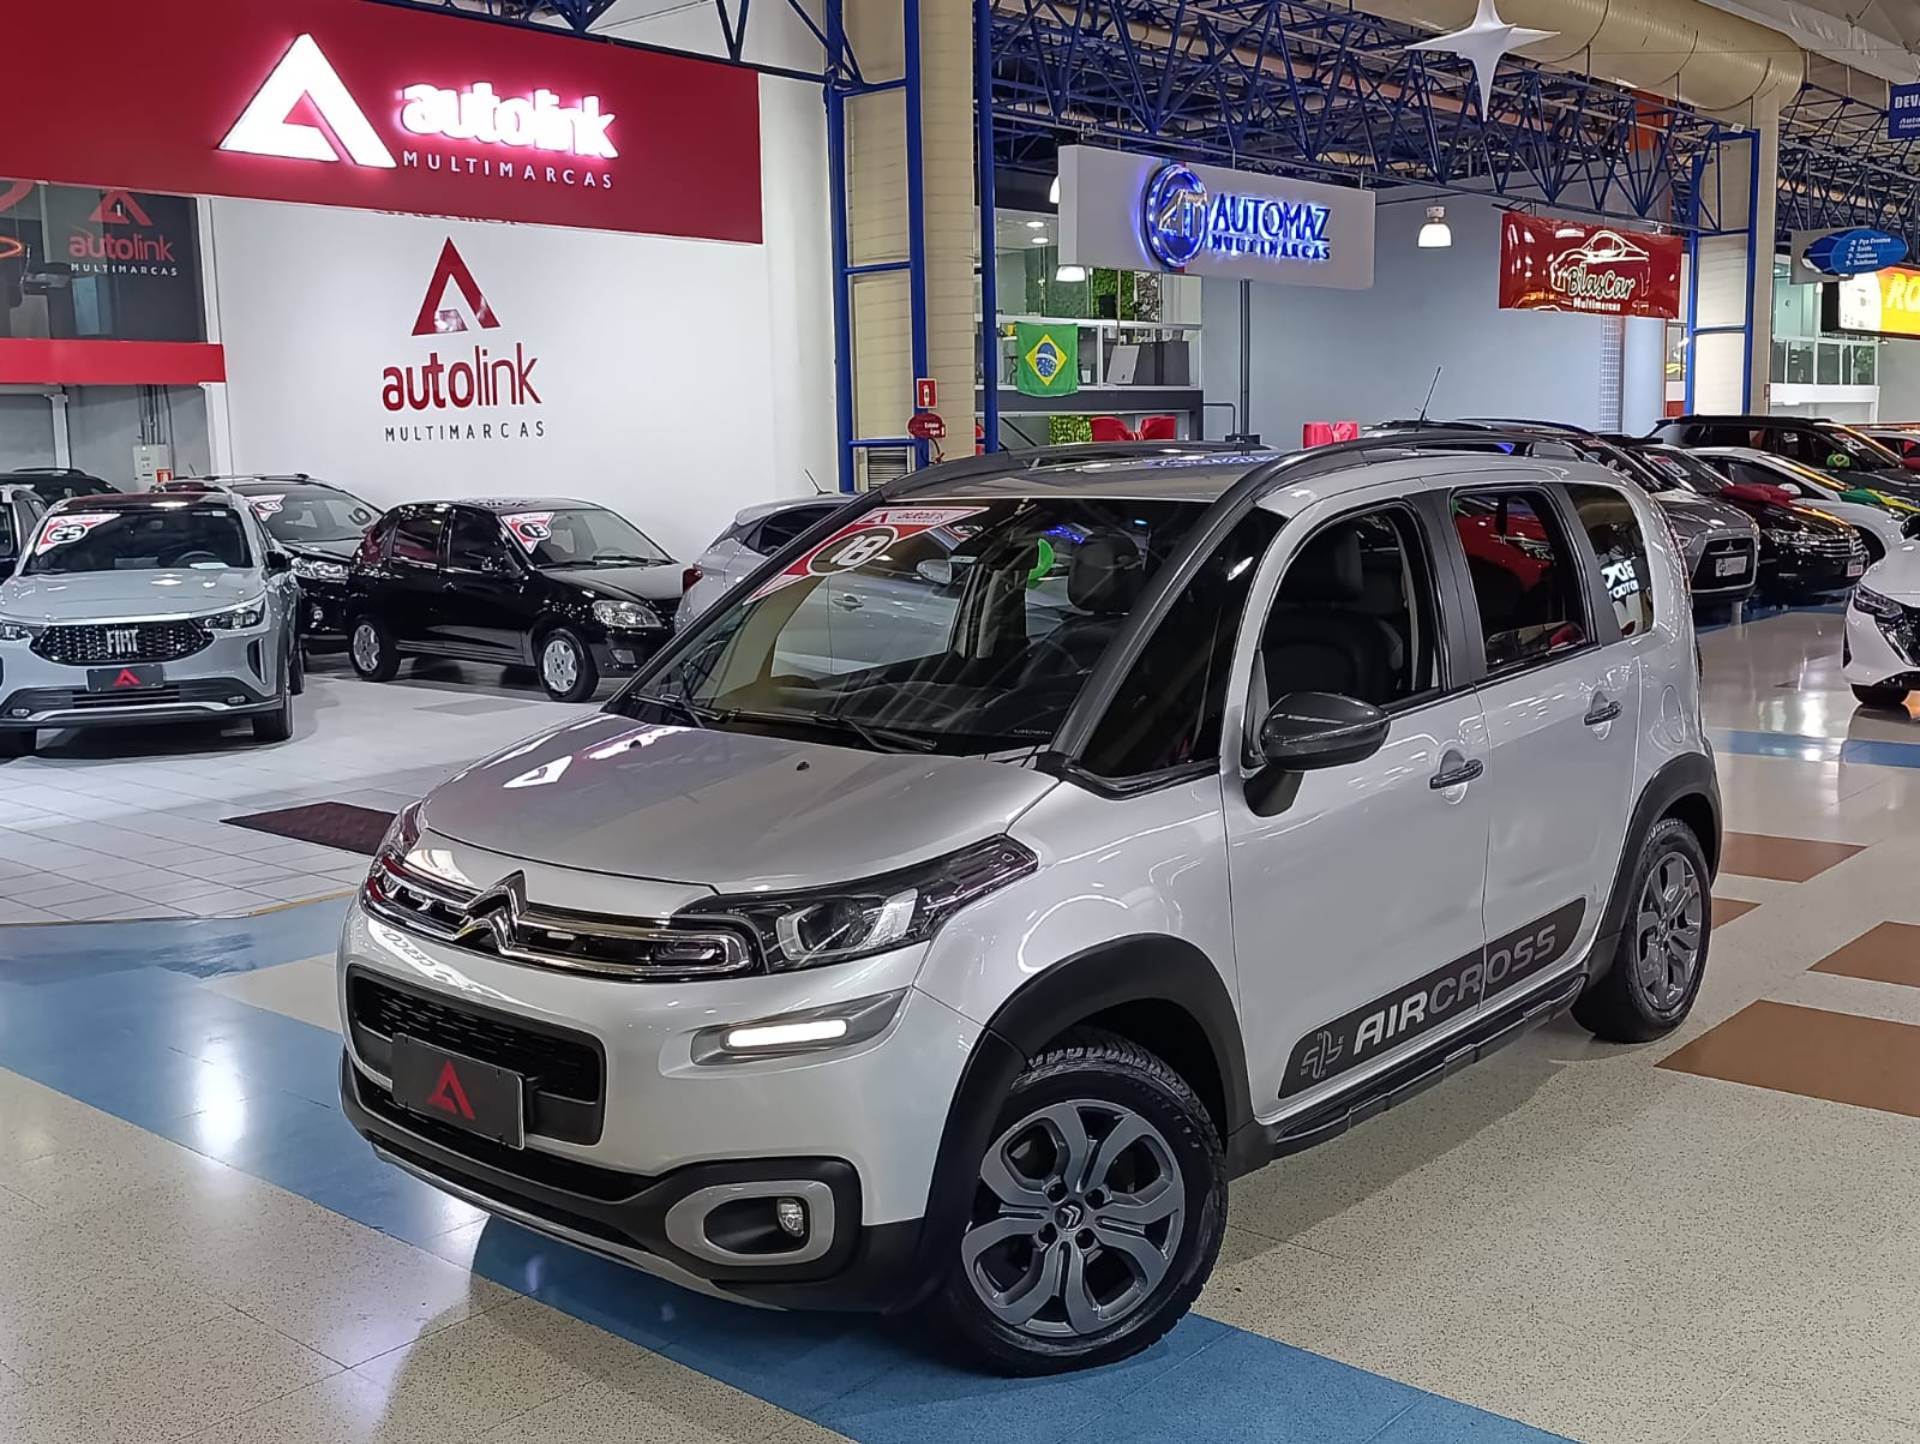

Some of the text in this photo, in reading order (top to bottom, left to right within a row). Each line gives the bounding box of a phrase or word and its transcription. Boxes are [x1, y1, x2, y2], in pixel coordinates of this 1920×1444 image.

[1894, 94, 1920, 109] DEV
[401, 80, 618, 159] autolink
[403, 151, 614, 190] MULTIMARCAS
[1212, 193, 1332, 242] AUTOMAZ
[69, 233, 176, 262] autolink
[1211, 233, 1331, 260] MULTIMARCAS
[71, 263, 178, 276] MULTIMARCAS
[1567, 263, 1637, 301] BlasCar
[382, 342, 542, 412] autolink
[385, 420, 545, 443] MULTIMARCAS
[51, 526, 83, 541] 25
[105, 629, 139, 654] FIAT
[1352, 923, 1557, 1056] AIRCROSS
